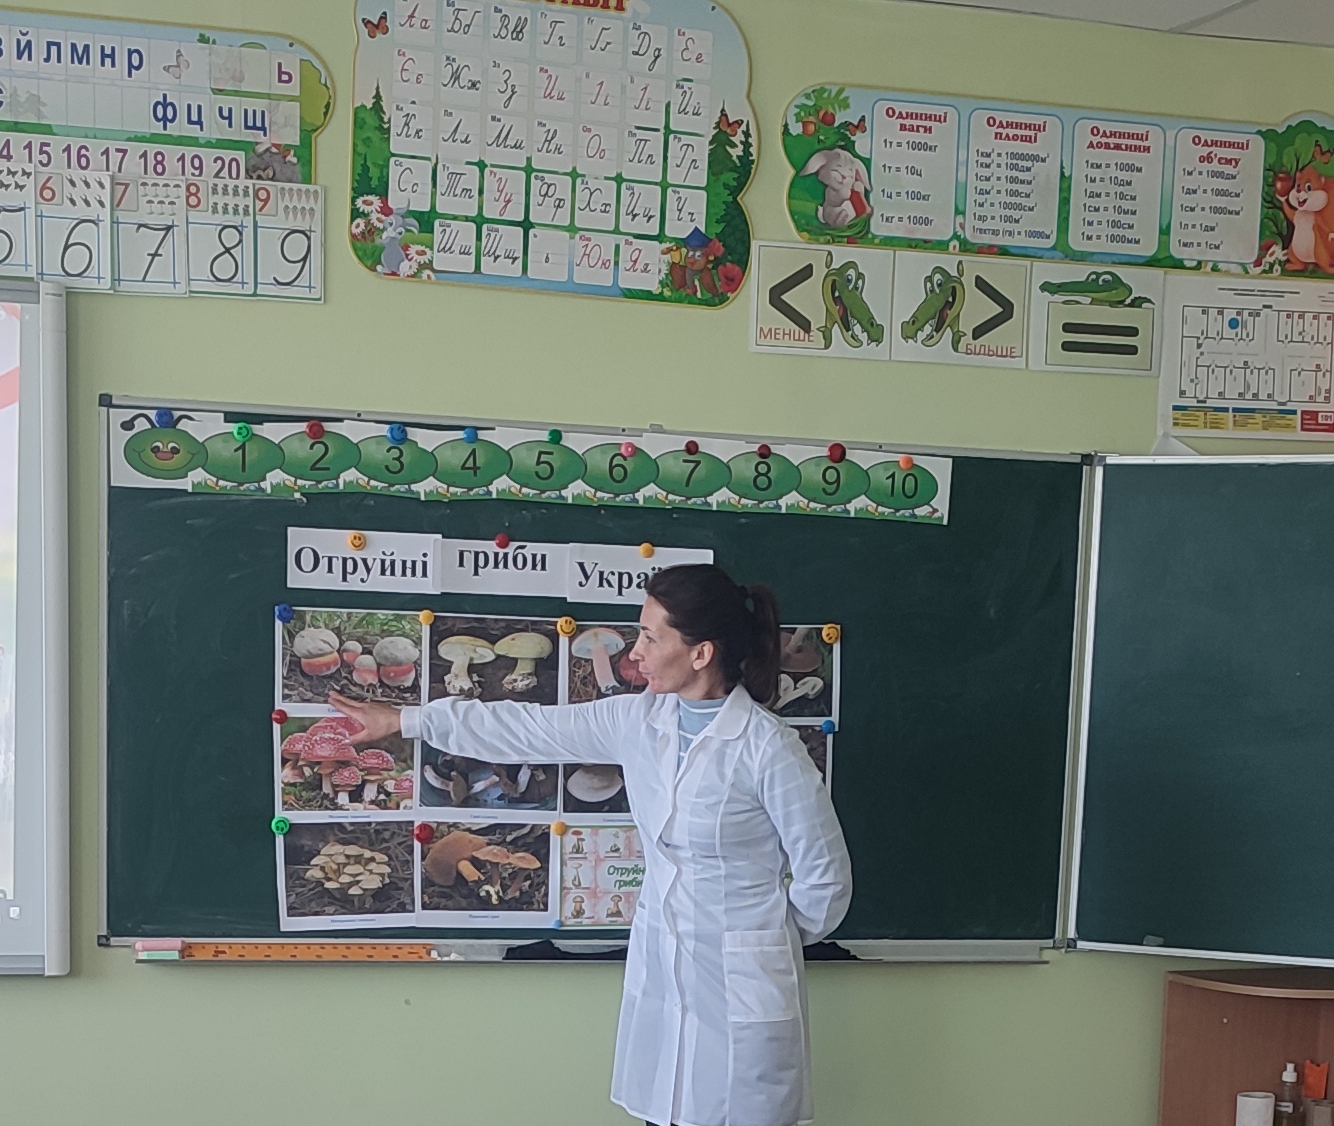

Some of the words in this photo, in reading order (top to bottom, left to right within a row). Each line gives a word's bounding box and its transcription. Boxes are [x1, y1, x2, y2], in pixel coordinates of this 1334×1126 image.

[885, 106, 948, 124] Одиниці
[899, 122, 933, 135] ваги
[986, 115, 1047, 133] Одиниці
[994, 132, 1038, 144] площі
[1090, 125, 1150, 142] Одиниці
[1086, 140, 1151, 154] довжини
[1192, 135, 1250, 151] Одиниці
[23, 140, 52, 168] 15
[61, 143, 91, 171] 16
[100, 146, 128, 174] 17
[138, 149, 167, 176] 18
[176, 152, 204, 178] 19
[212, 155, 241, 181] 20
[39, 176, 56, 203] 6
[116, 182, 131, 209] 7
[186, 182, 201, 209] 8
[255, 186, 271, 213] 9
[61, 219, 99, 278] 6
[136, 222, 177, 281] 7
[209, 225, 243, 281] 8
[272, 229, 311, 286] 9
[758, 326, 815, 343] МЕНШЕ
[965, 343, 1017, 359] БІЛЬШЕ
[233, 447, 247, 473] 1
[309, 440, 331, 472] 2
[384, 445, 405, 475] 3
[460, 446, 481, 476] 4
[534, 450, 555, 481] 5
[608, 452, 629, 484] 6
[681, 459, 702, 488] 7
[752, 461, 773, 492] 8
[821, 465, 842, 497] 9
[885, 472, 918, 500] 10
[292, 544, 430, 584] Отруйні
[457, 545, 548, 577] гриби
[575, 559, 662, 591] Укра
[607, 863, 646, 878] Отруйн
